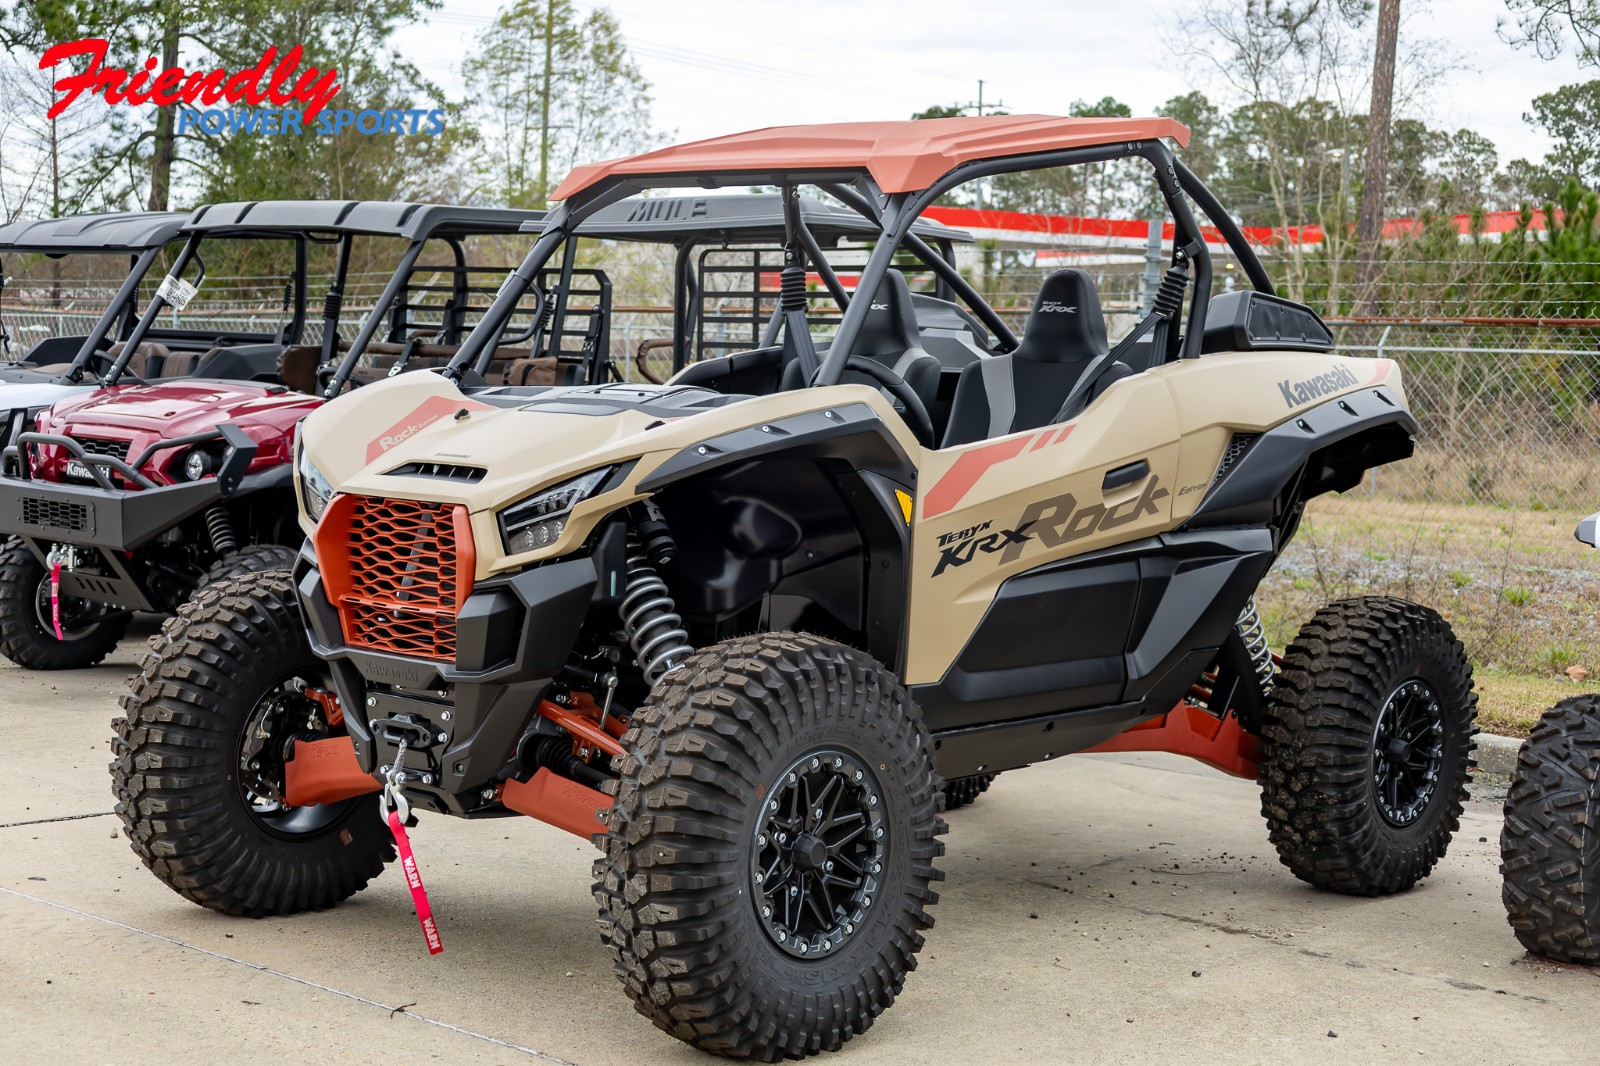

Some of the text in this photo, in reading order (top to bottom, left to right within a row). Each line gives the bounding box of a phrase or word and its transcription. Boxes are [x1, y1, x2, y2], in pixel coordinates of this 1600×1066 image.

[624, 198, 708, 222] MULE
[1038, 305, 1078, 313] KRX
[1277, 363, 1359, 408] Kawasaki
[378, 425, 419, 452] Rock
[936, 519, 994, 547] TERYX
[997, 474, 1170, 567] Rock
[930, 519, 1038, 578] KRX
[365, 661, 419, 682] Kawasaki
[403, 855, 421, 889] WARN
[423, 916, 441, 950] WARN
